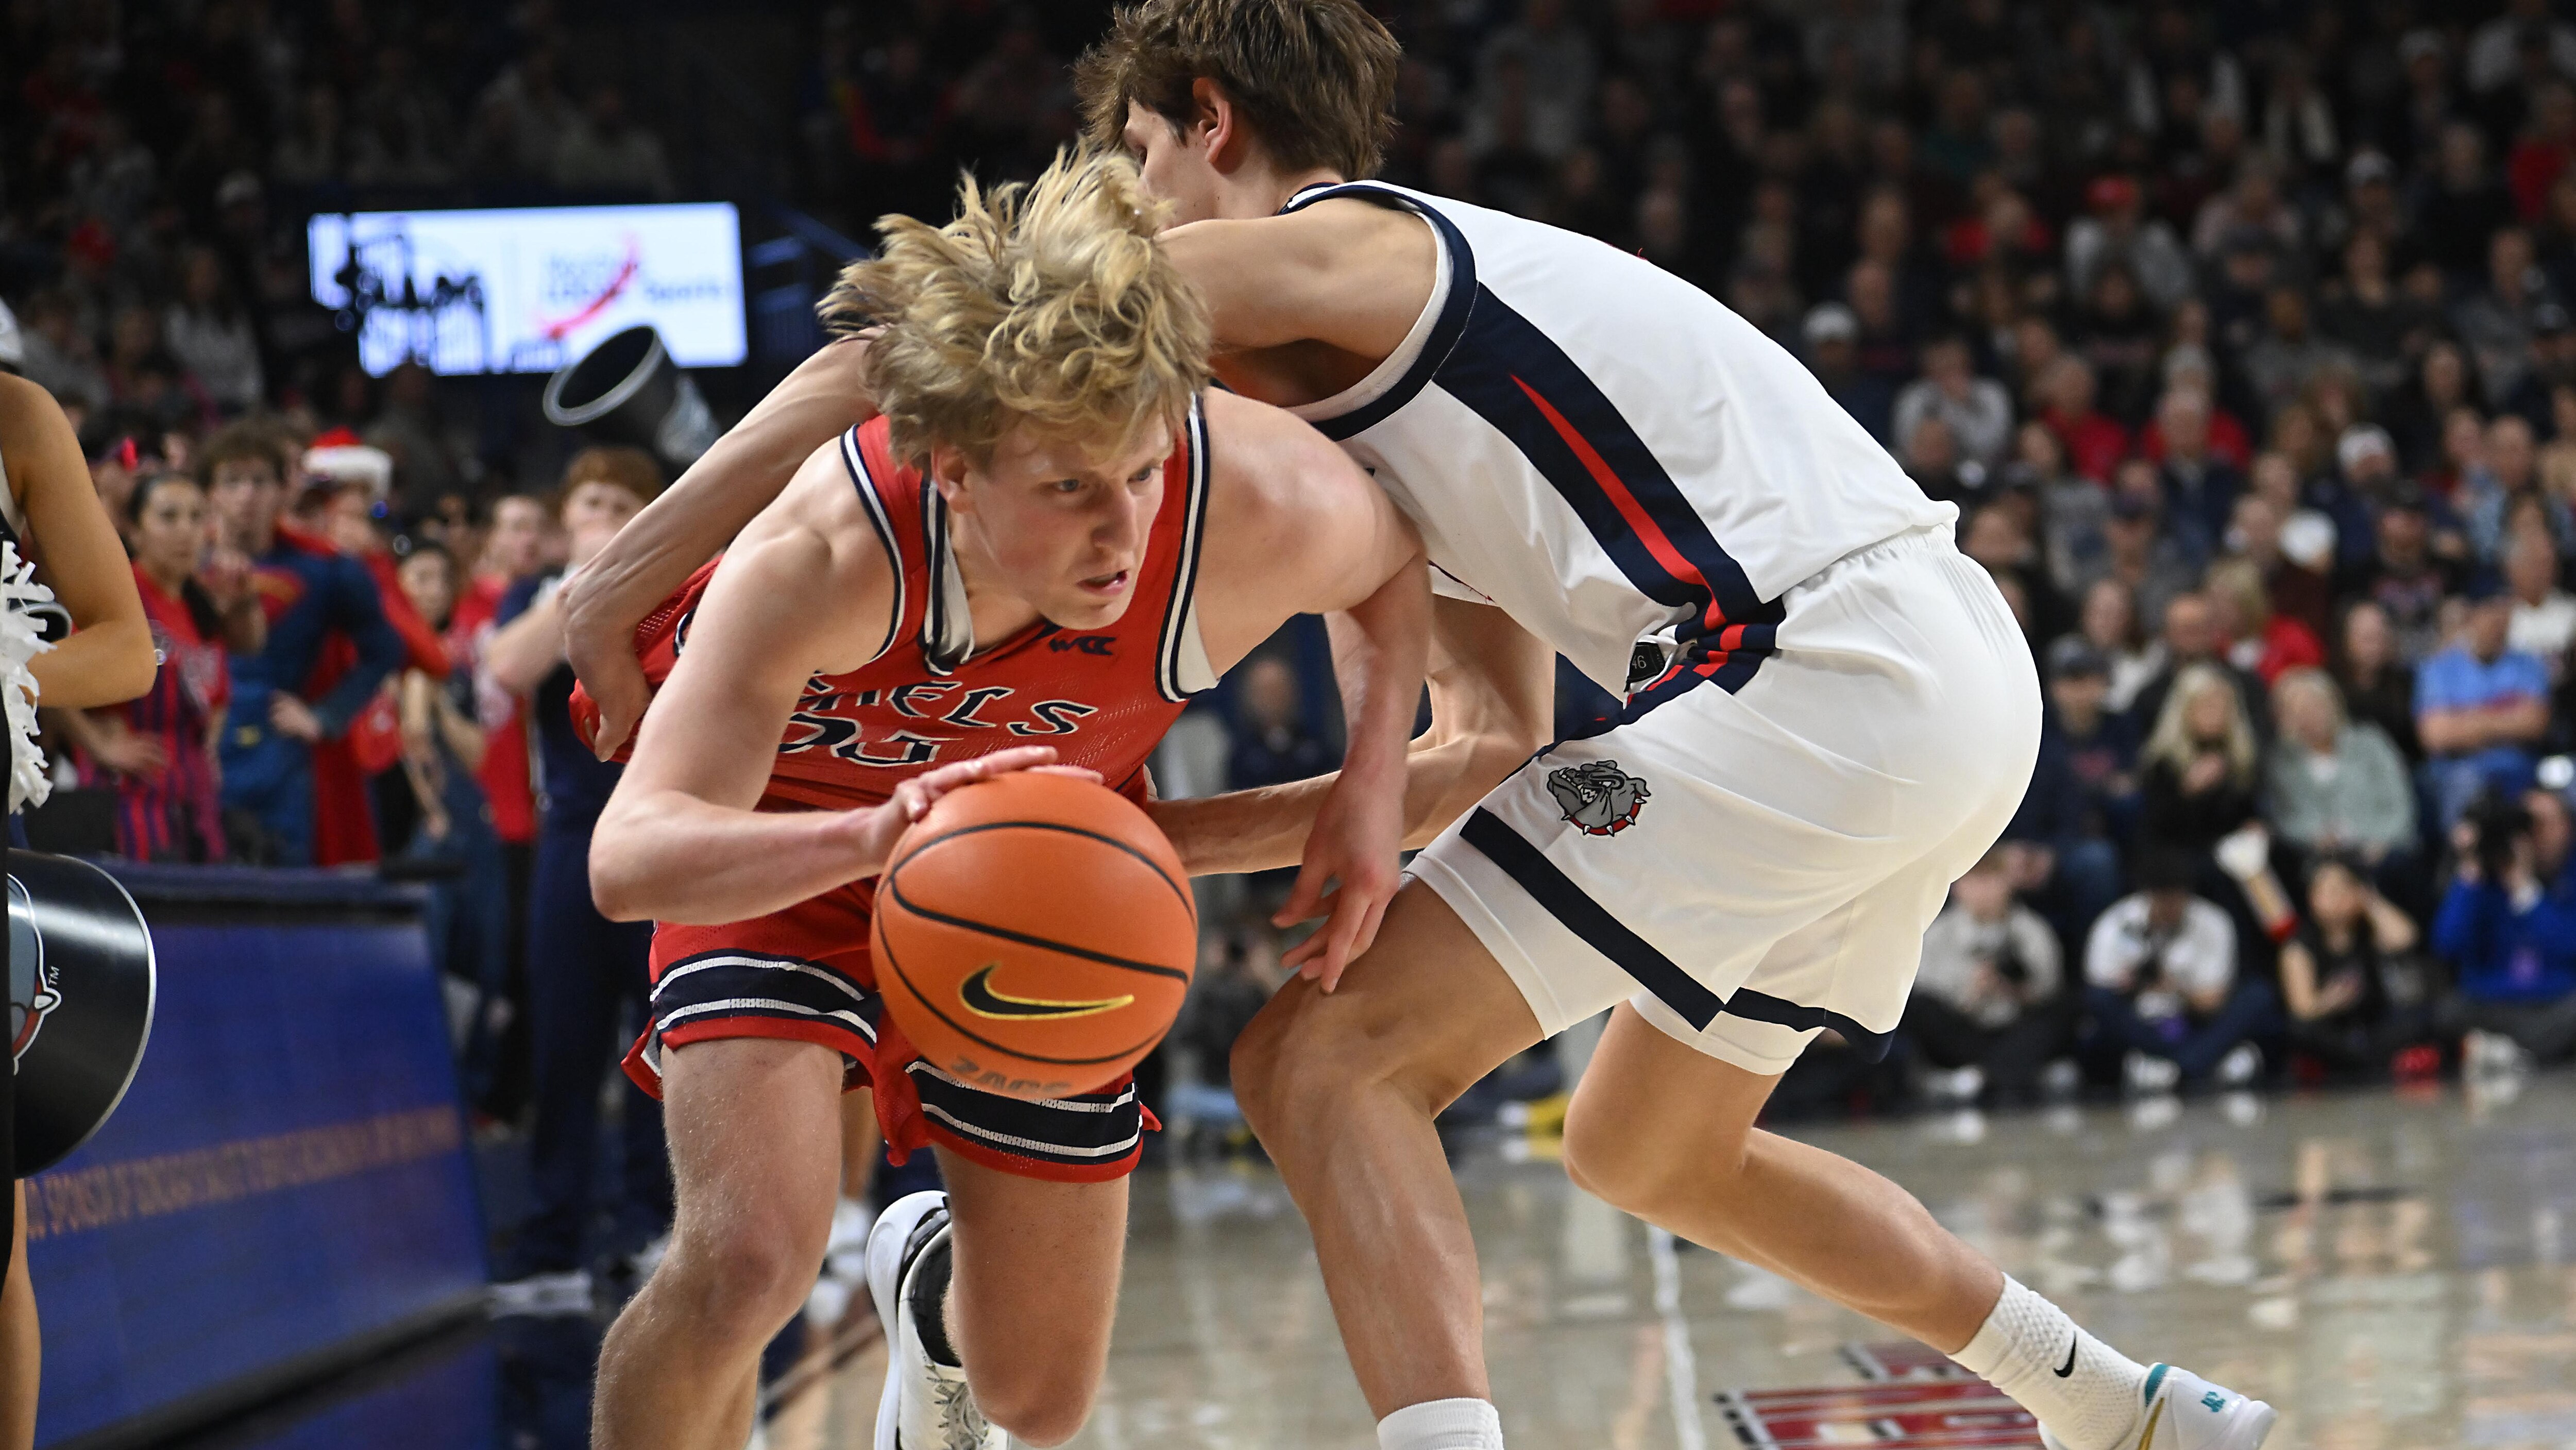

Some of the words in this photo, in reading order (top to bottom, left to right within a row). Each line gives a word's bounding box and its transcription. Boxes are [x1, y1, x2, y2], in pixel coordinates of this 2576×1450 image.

[1049, 635, 1117, 655] WCC
[799, 678, 1098, 736] ELS
[48, 965, 60, 985] TM
